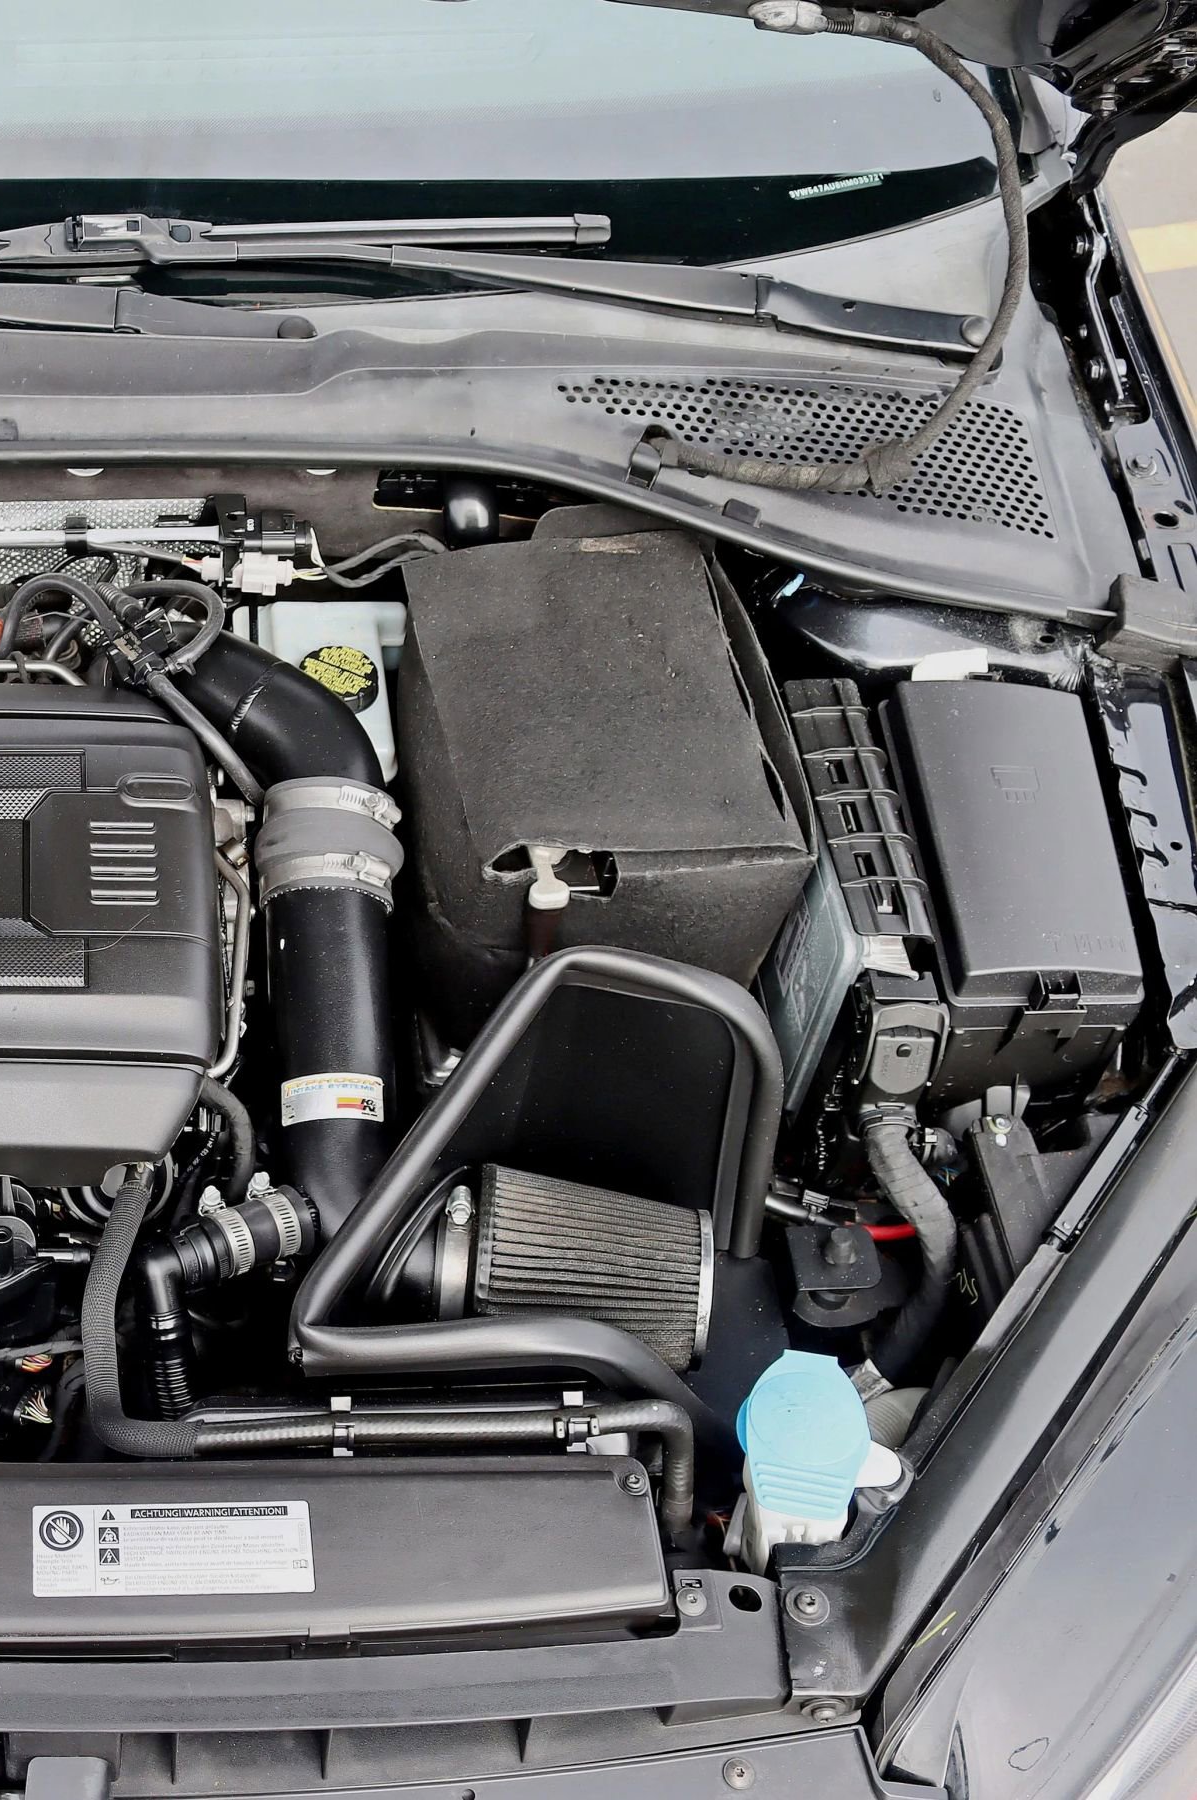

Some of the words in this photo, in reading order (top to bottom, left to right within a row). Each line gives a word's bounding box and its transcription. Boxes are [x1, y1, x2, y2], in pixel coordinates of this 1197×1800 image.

[134, 1509, 181, 1518] ACHTUNG!
[183, 1508, 231, 1517] WARNING!
[232, 1507, 285, 1517] ATTENTION!
